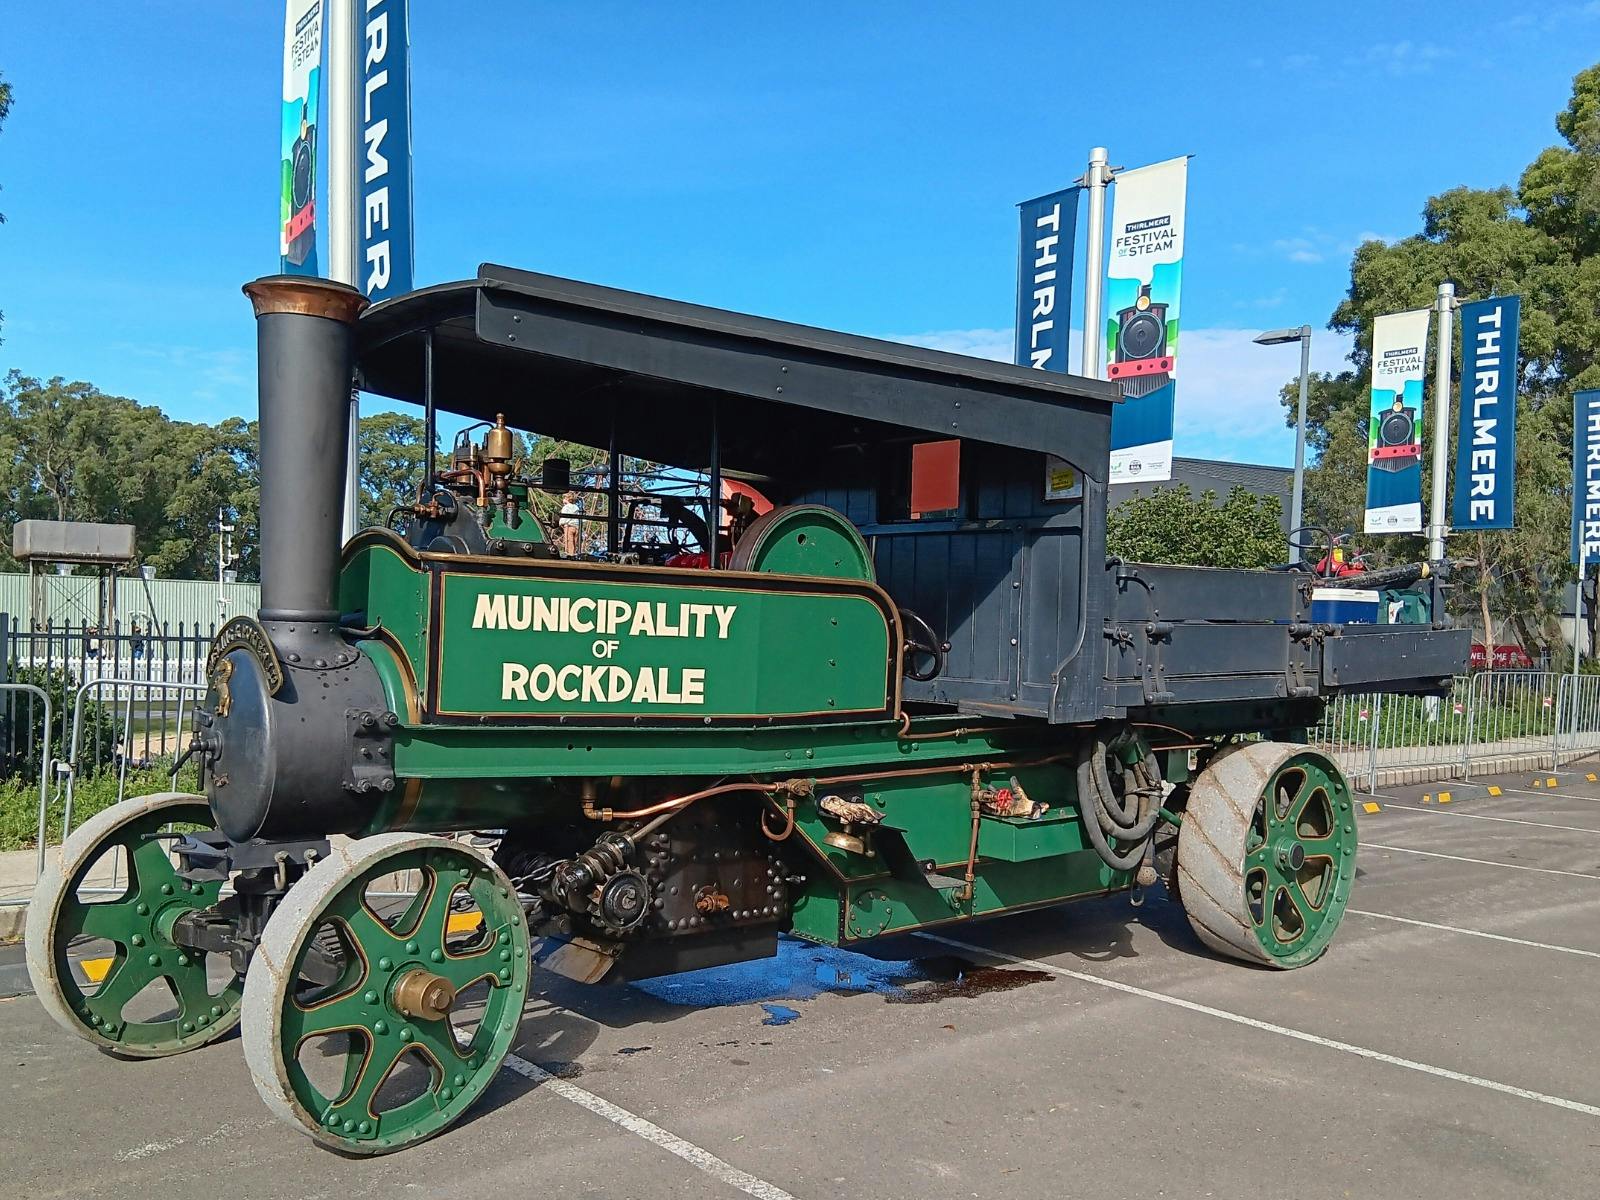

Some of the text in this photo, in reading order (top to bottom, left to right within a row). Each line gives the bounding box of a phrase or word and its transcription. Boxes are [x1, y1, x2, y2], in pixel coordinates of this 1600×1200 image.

[1126, 217, 1170, 232] THIRLMERE
[1116, 228, 1178, 247] FESTIVAL
[1129, 240, 1173, 256] STEAM
[1377, 356, 1423, 368] FESTIVAL
[1387, 364, 1420, 374] STEAM
[1470, 306, 1502, 521] THIRLMERE
[472, 593, 736, 639] MUNICIPALITY
[592, 640, 620, 659] OF
[501, 662, 706, 704] ROCKDALE
